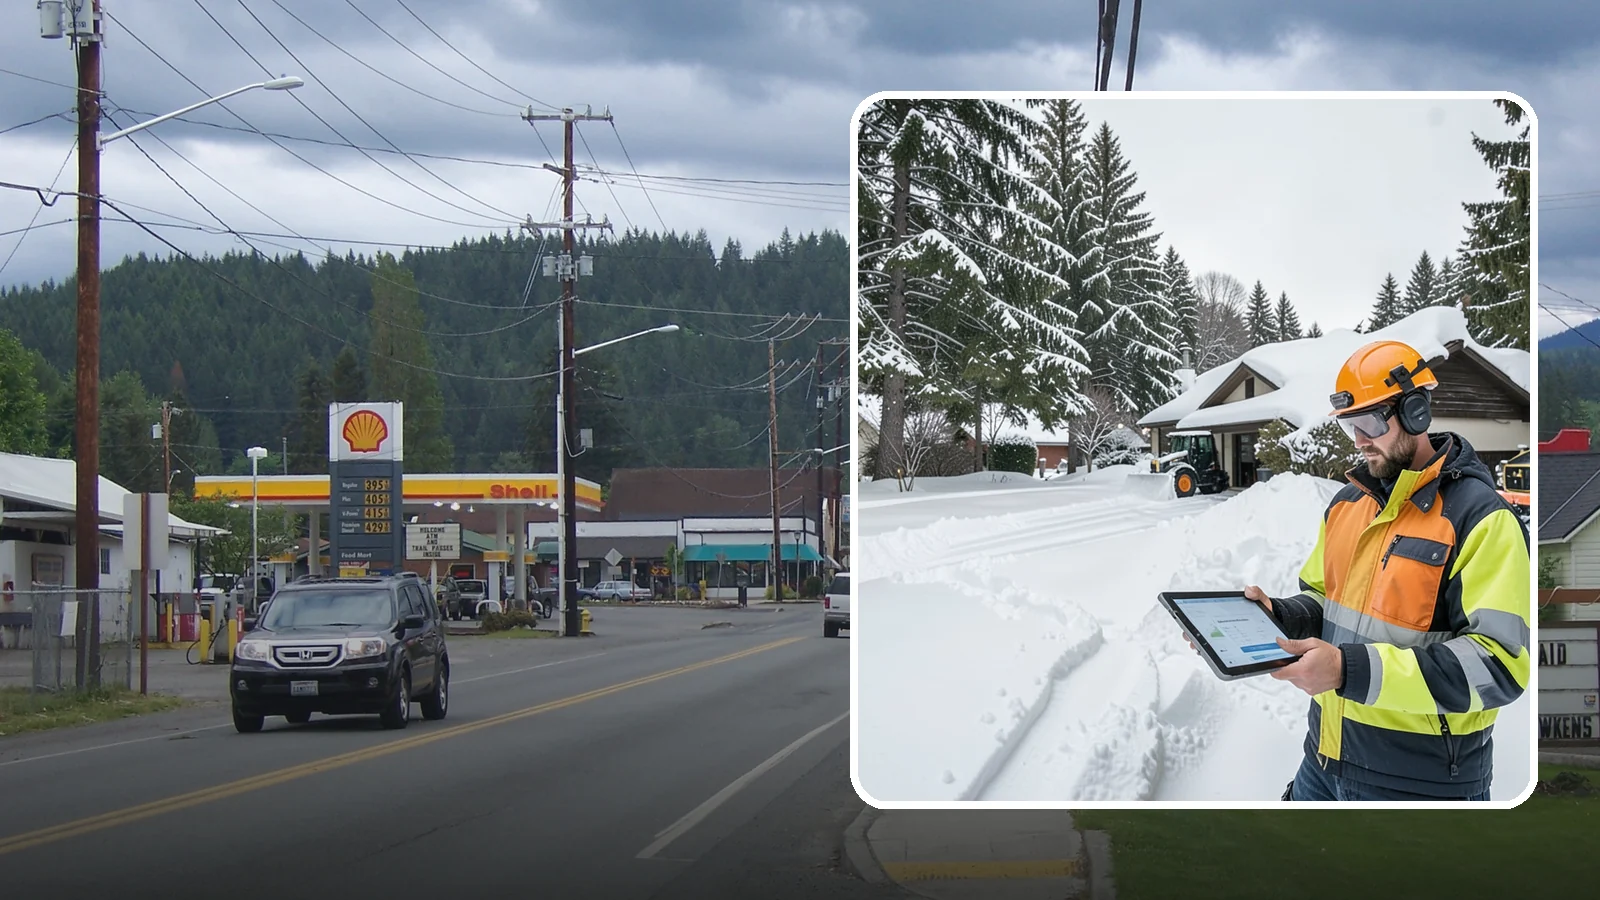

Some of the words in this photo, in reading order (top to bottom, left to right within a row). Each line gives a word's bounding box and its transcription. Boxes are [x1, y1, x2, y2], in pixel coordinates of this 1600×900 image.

[366, 480, 383, 490] 395
[490, 484, 547, 499] Shell
[366, 494, 383, 504] 405
[366, 508, 383, 518] 415
[366, 522, 383, 532] 429
